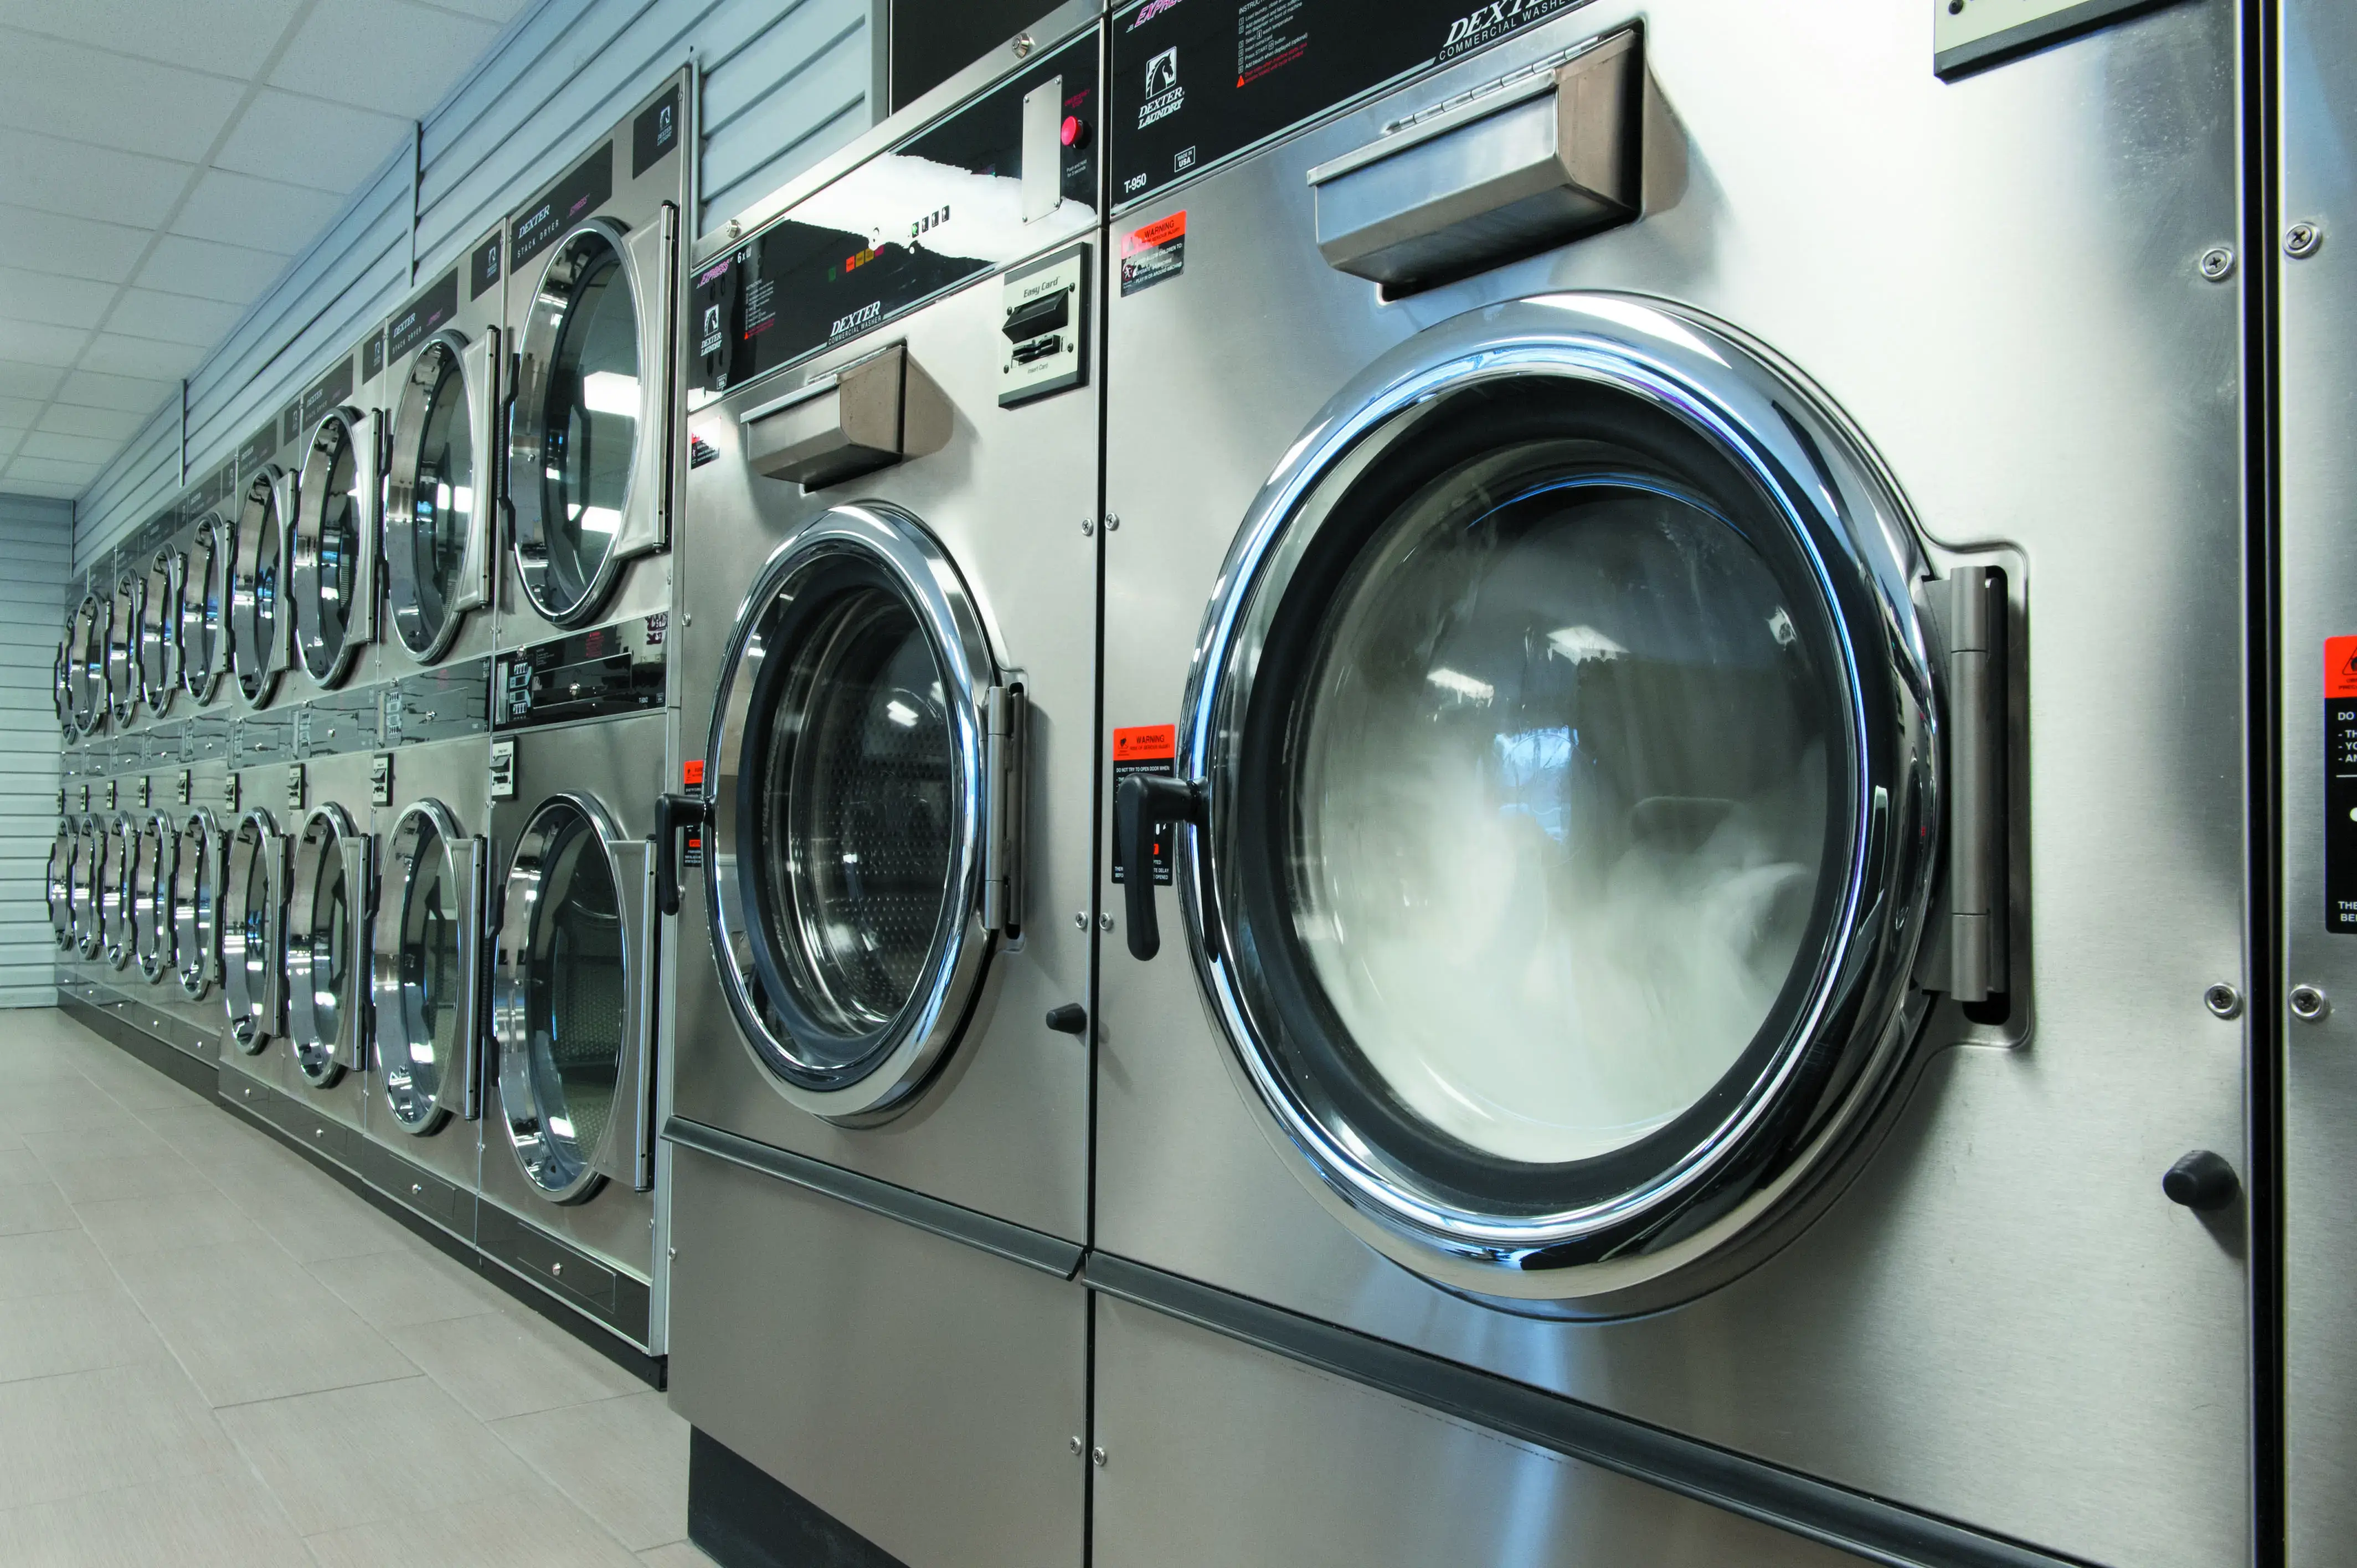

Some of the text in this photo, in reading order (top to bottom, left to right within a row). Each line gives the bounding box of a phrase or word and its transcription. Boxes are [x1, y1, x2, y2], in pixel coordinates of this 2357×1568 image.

[1439, 18, 1517, 61] COMMERCIAL
[1255, 45, 1268, 55] START
[1138, 86, 1183, 118] DEXTER
[1138, 97, 1184, 130] LAUNDRY
[1179, 157, 1191, 167] USA
[1124, 173, 1147, 193] T-950
[518, 204, 550, 239] DEXTER
[1144, 220, 1175, 238] WARNING
[517, 219, 559, 259] STACK DRYER
[737, 252, 742, 264] 6
[1023, 277, 1058, 298] Easy Card
[830, 301, 881, 337] DEXTER
[828, 315, 882, 345] COMMERCIAL WASHER
[701, 332, 722, 349] DEXTER
[2338, 711, 2355, 720] DO
[1136, 735, 1164, 744] WARNING
